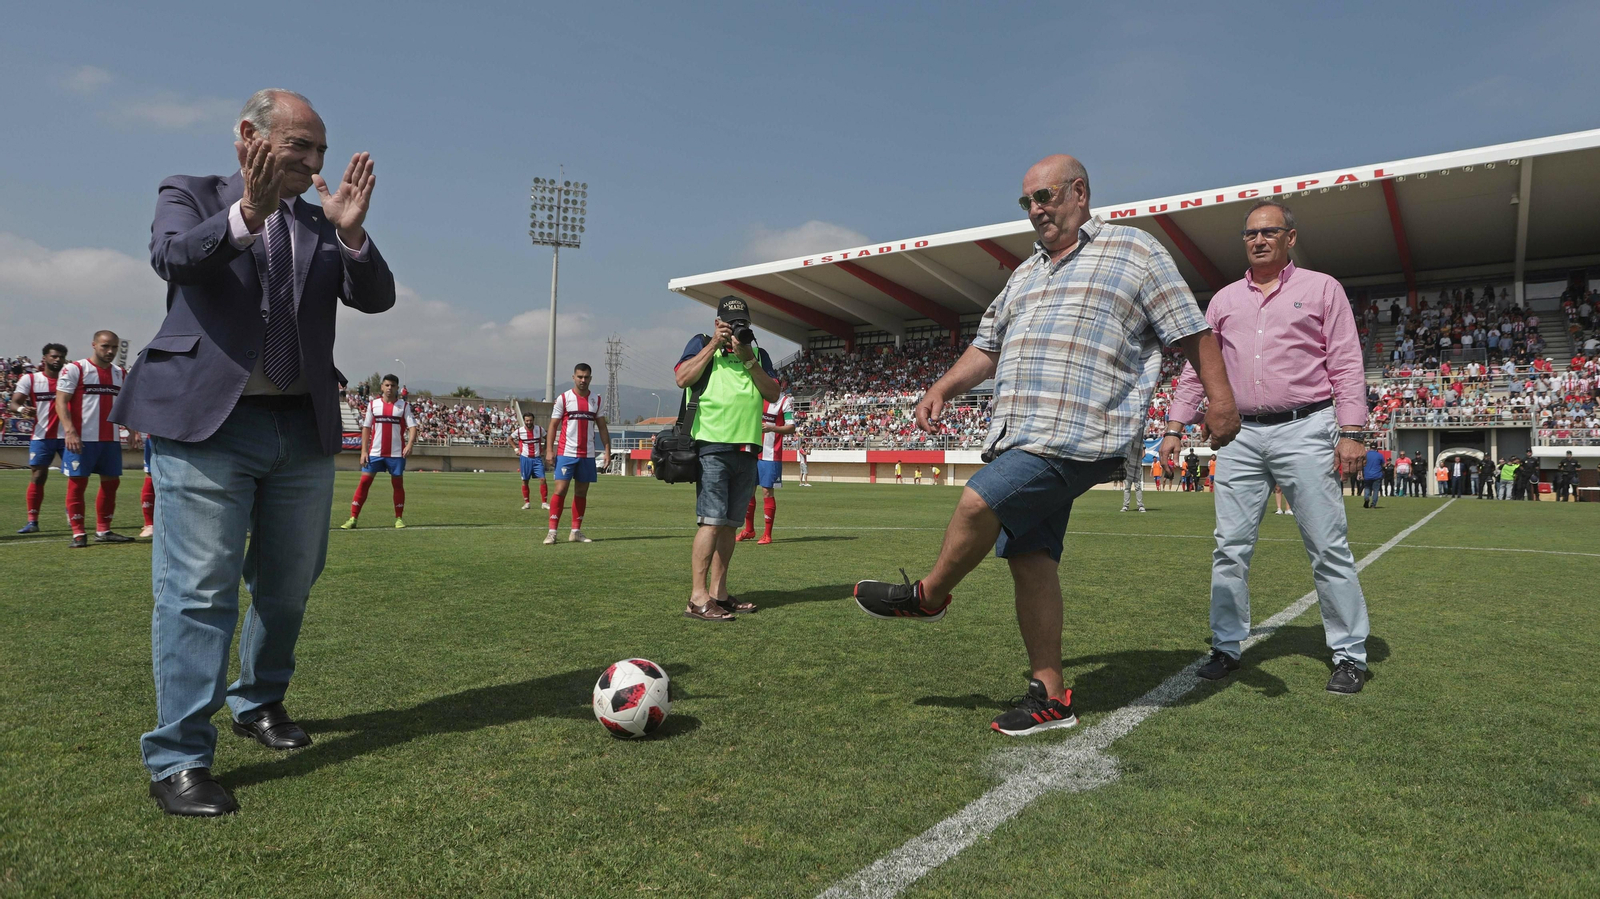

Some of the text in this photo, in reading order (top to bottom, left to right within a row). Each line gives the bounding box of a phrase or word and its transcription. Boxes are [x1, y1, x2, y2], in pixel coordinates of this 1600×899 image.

[803, 168, 1394, 266] ESTADIO MUNICIPAL
[119, 340, 129, 367] VECO
